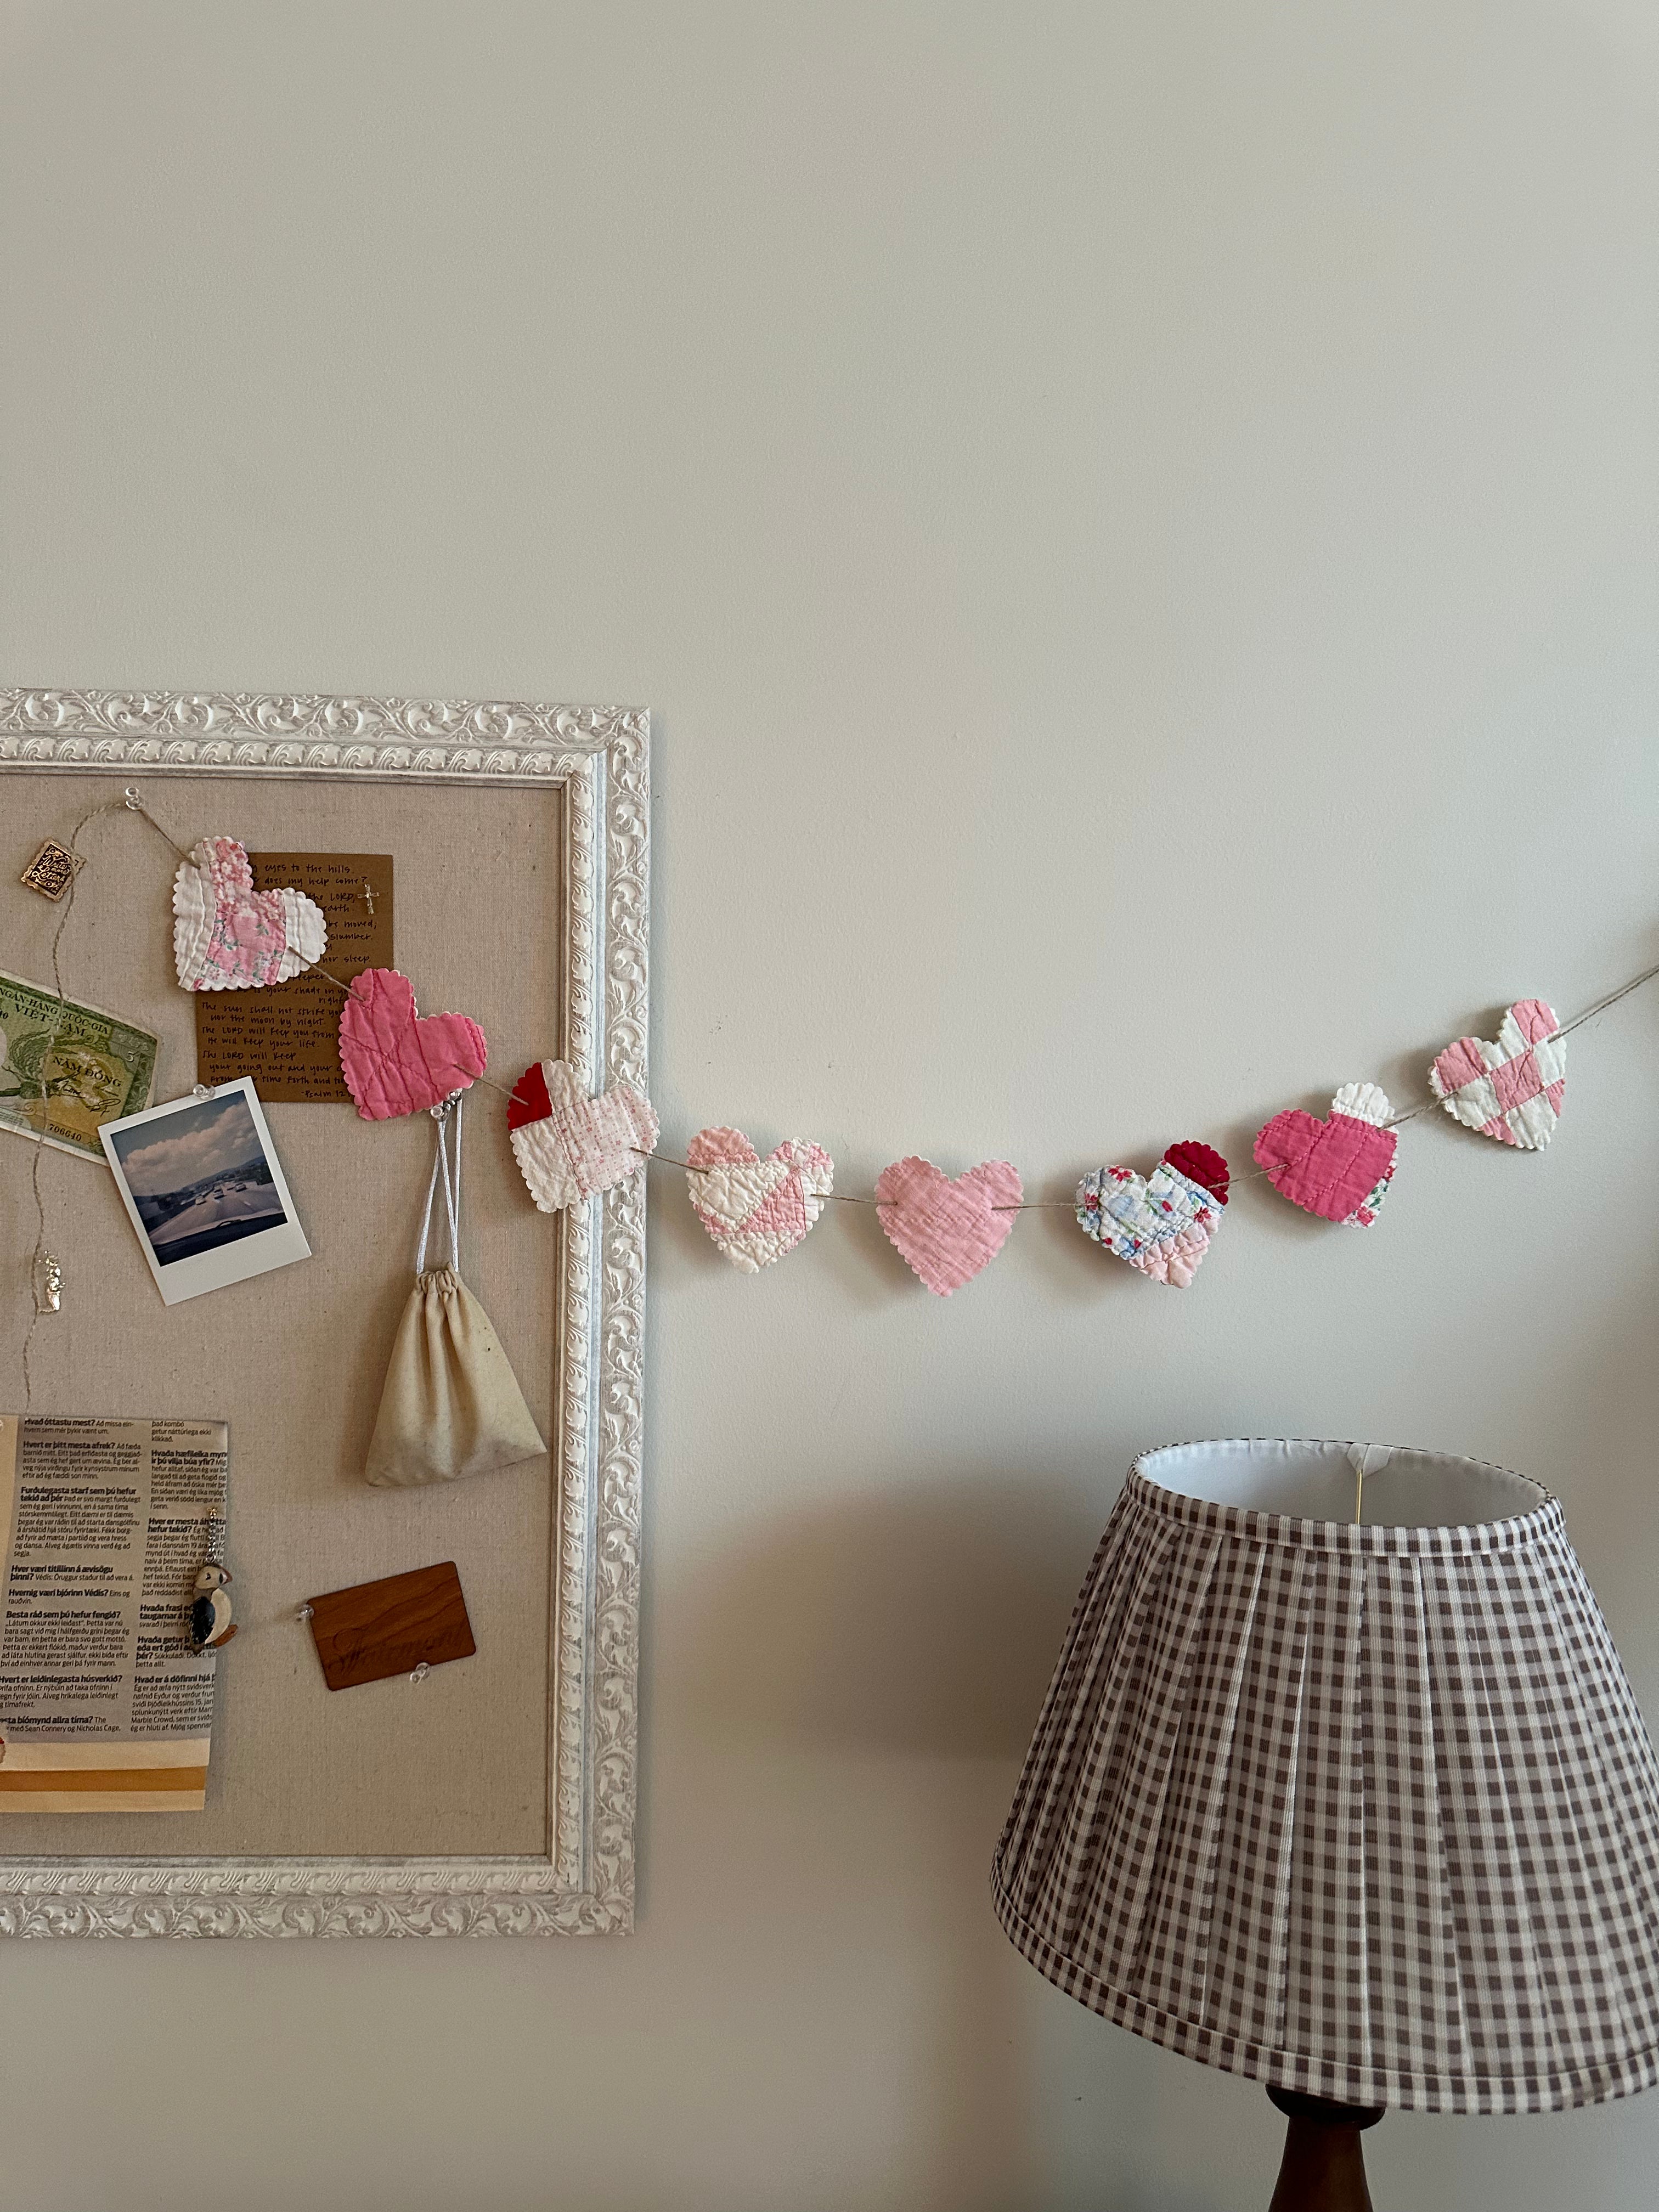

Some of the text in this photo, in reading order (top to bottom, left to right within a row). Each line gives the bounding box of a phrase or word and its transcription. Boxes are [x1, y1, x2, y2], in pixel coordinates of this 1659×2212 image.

[265, 865, 286, 873] eyes
[306, 864, 322, 873] the
[288, 878, 302, 887] my
[309, 877, 329, 886] help
[331, 893, 355, 903] LORD,
[266, 988, 291, 997] your
[319, 996, 344, 1005] right
[202, 1002, 216, 1011] The
[250, 1006, 273, 1014] shall
[15, 1004, 86, 1036] VIỆT-AM
[280, 1018, 291, 1027] by
[270, 1026, 290, 1037] keep
[311, 1029, 334, 1039] from
[208, 1037, 217, 1045] He
[244, 1037, 264, 1046] keep
[269, 1041, 294, 1050] your
[125, 1051, 134, 1062] 5
[202, 1050, 296, 1060] The LORD will keep
[237, 1064, 263, 1074] going
[309, 1065, 333, 1075] your
[49, 1124, 81, 1141] 706640
[92, 1441, 115, 1449] afrek?
[199, 1458, 214, 1466] yfir?
[21, 1486, 69, 1497] Furðulegasta
[82, 1565, 114, 1574] ævisögu
[10, 1573, 34, 1581] þinni?
[57, 1589, 83, 1598] bjórinn
[93, 1611, 121, 1620] fengið?
[165, 1644, 179, 1652] góð
[136, 1652, 153, 1660] þér?
[30, 1675, 80, 1684] leiðinlegasta
[81, 1674, 122, 1683] húsverkið?
[199, 1674, 210, 1683] hjá
[18, 1716, 52, 1725] bíómynd
[71, 1716, 93, 1724] tíma?
